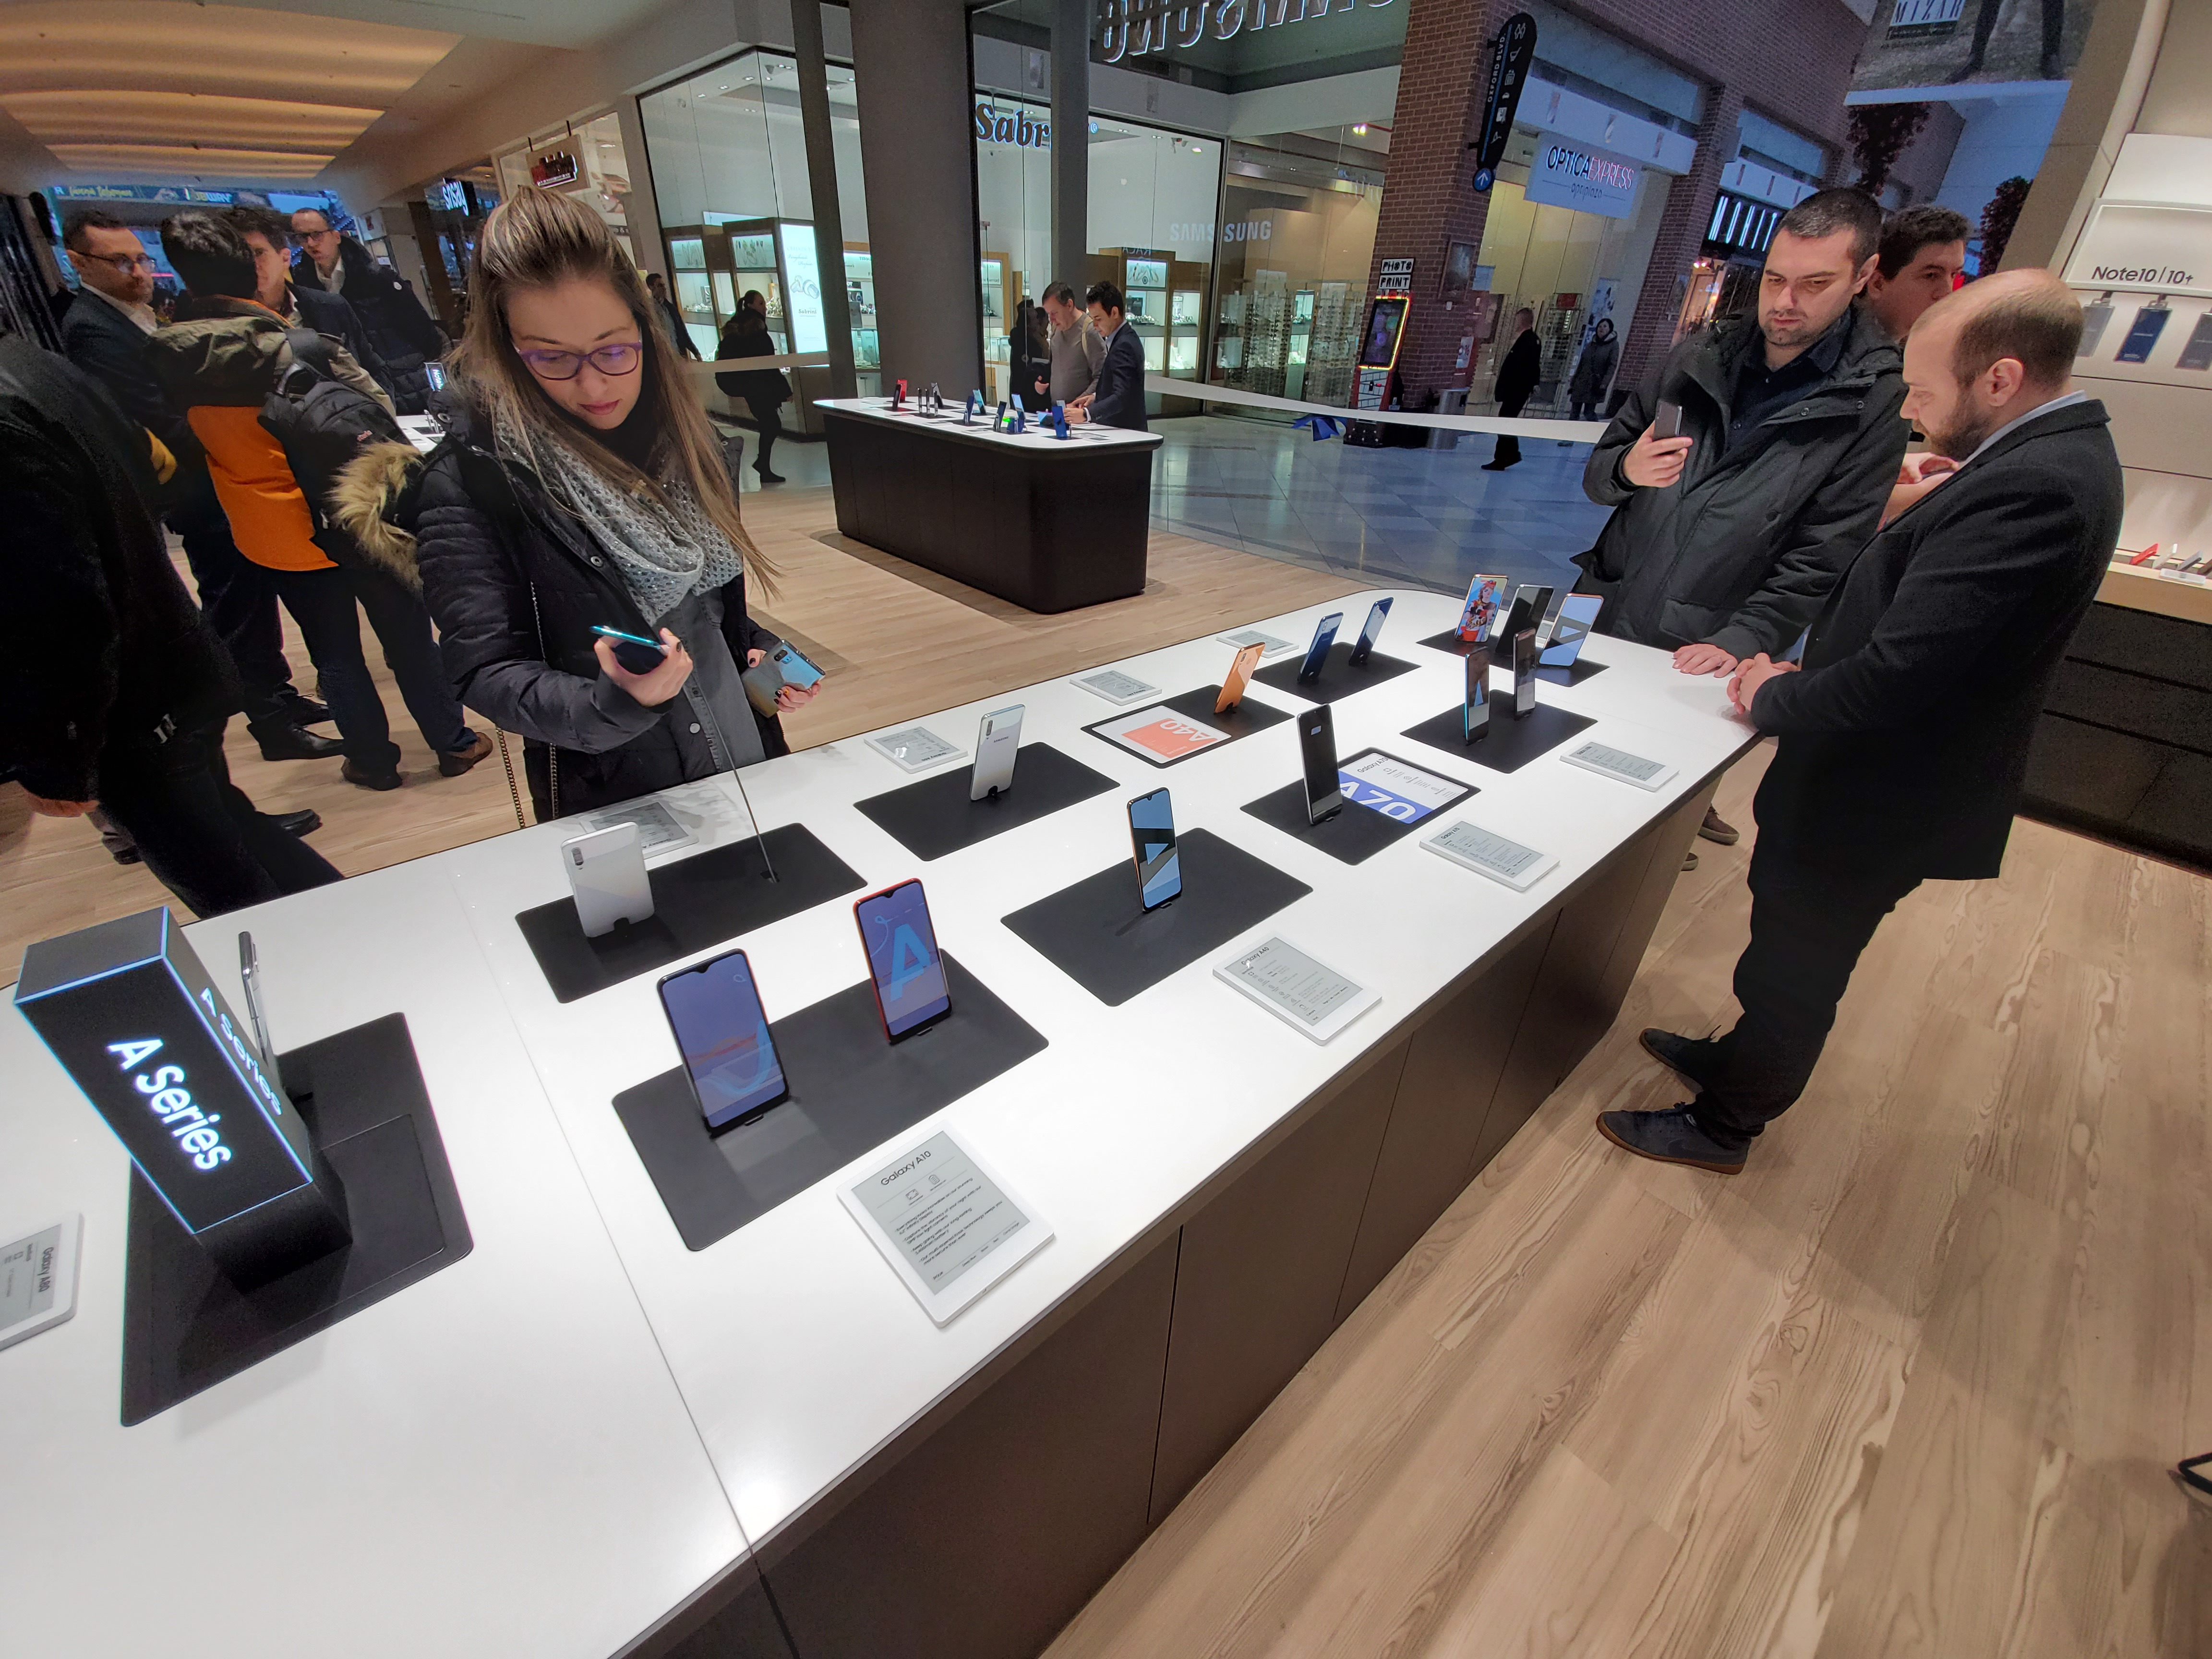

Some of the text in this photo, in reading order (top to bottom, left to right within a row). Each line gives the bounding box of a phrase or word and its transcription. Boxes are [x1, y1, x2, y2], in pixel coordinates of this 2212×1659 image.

[1488, 33, 1506, 102] OXFORD BLVD.
[976, 101, 1051, 148] Sabr
[1708, 195, 1778, 252] MOHIT
[1380, 277, 1409, 287] PRINT
[1382, 261, 1412, 272] PHOTO
[1357, 760, 1379, 773] Galaxy
[1339, 781, 1416, 819] A70
[1259, 947, 1269, 955] A40
[105, 1038, 231, 1170] A Series
[880, 1150, 931, 1186] Galaxy A10
[37, 1247, 54, 1275] Galaxy
